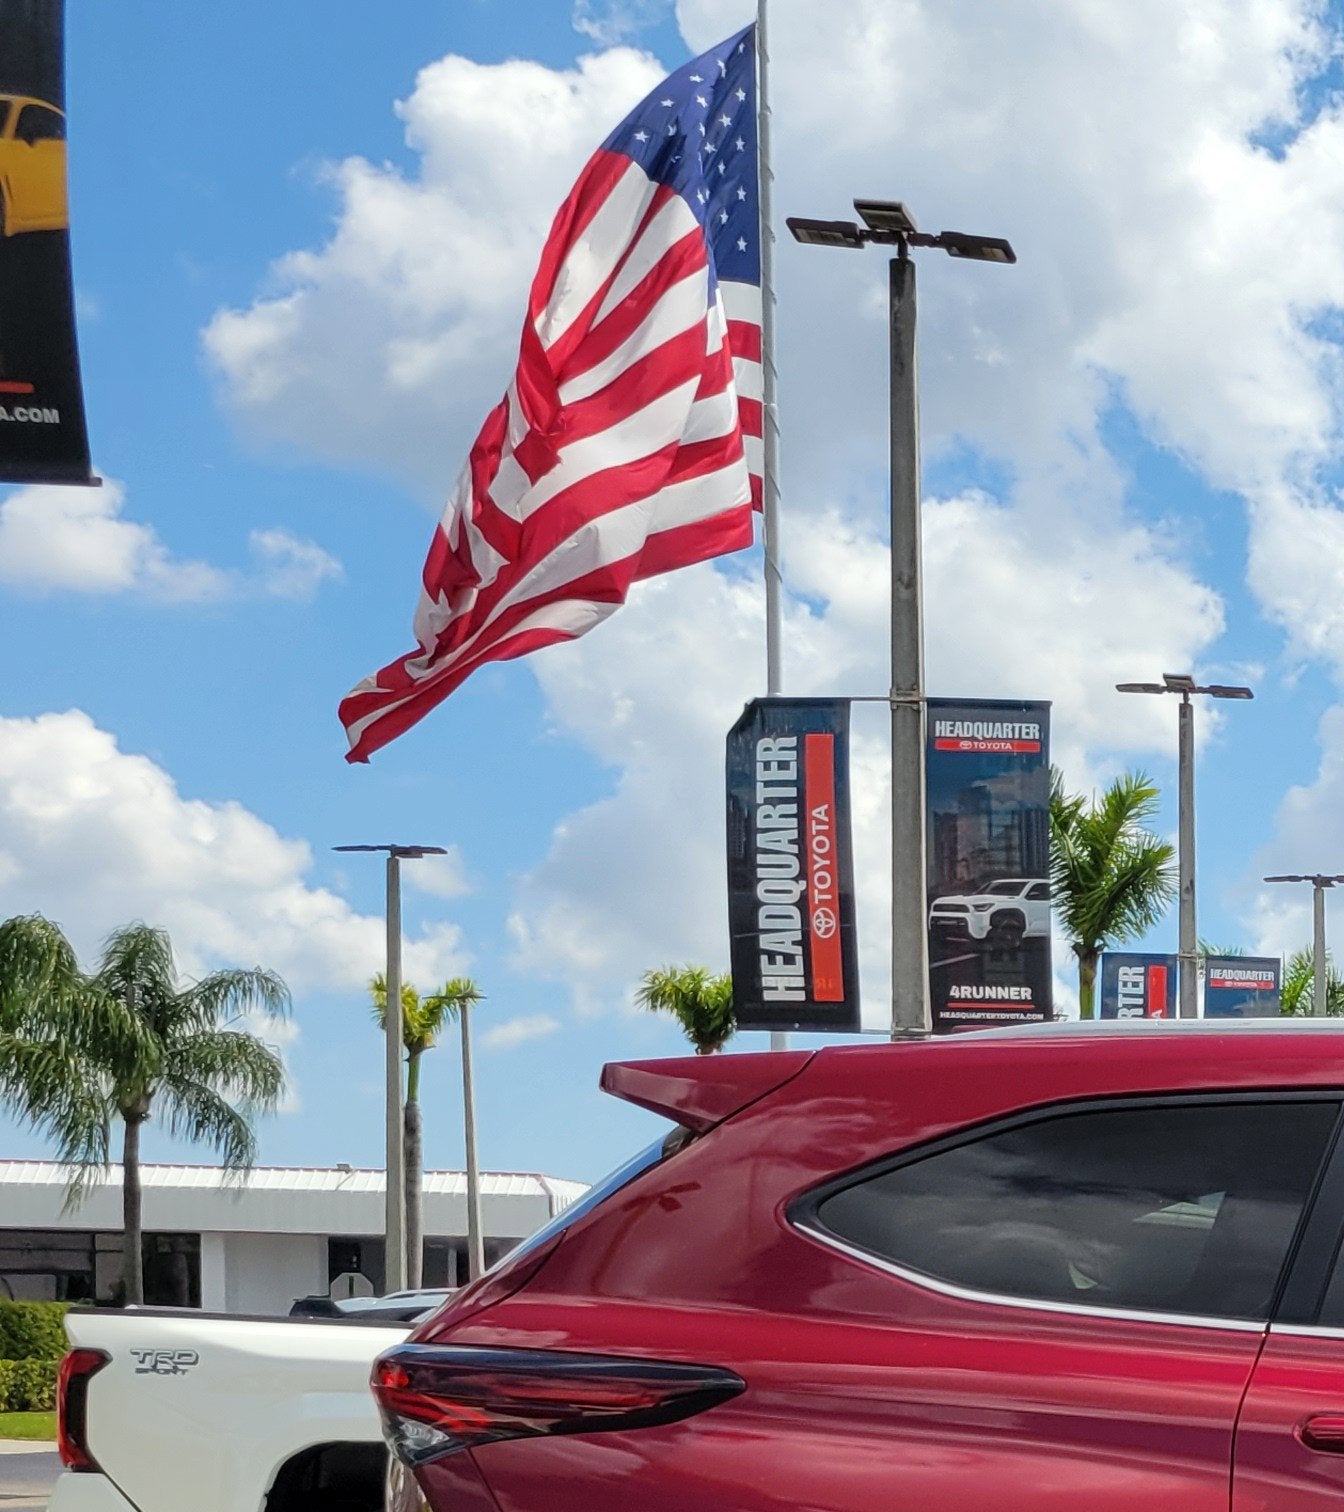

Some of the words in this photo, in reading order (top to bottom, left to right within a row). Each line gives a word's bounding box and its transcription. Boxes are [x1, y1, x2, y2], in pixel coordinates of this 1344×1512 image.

[934, 720, 1040, 740] HEADQUARTER
[972, 741, 1013, 751] TOYOTA
[811, 803, 833, 904] TOYOTA
[756, 735, 807, 1002] HEADQUARTER
[1209, 968, 1275, 982] HEADQUARTER
[949, 985, 1033, 1000] 4RUNNER
[130, 1349, 200, 1370] TRD
